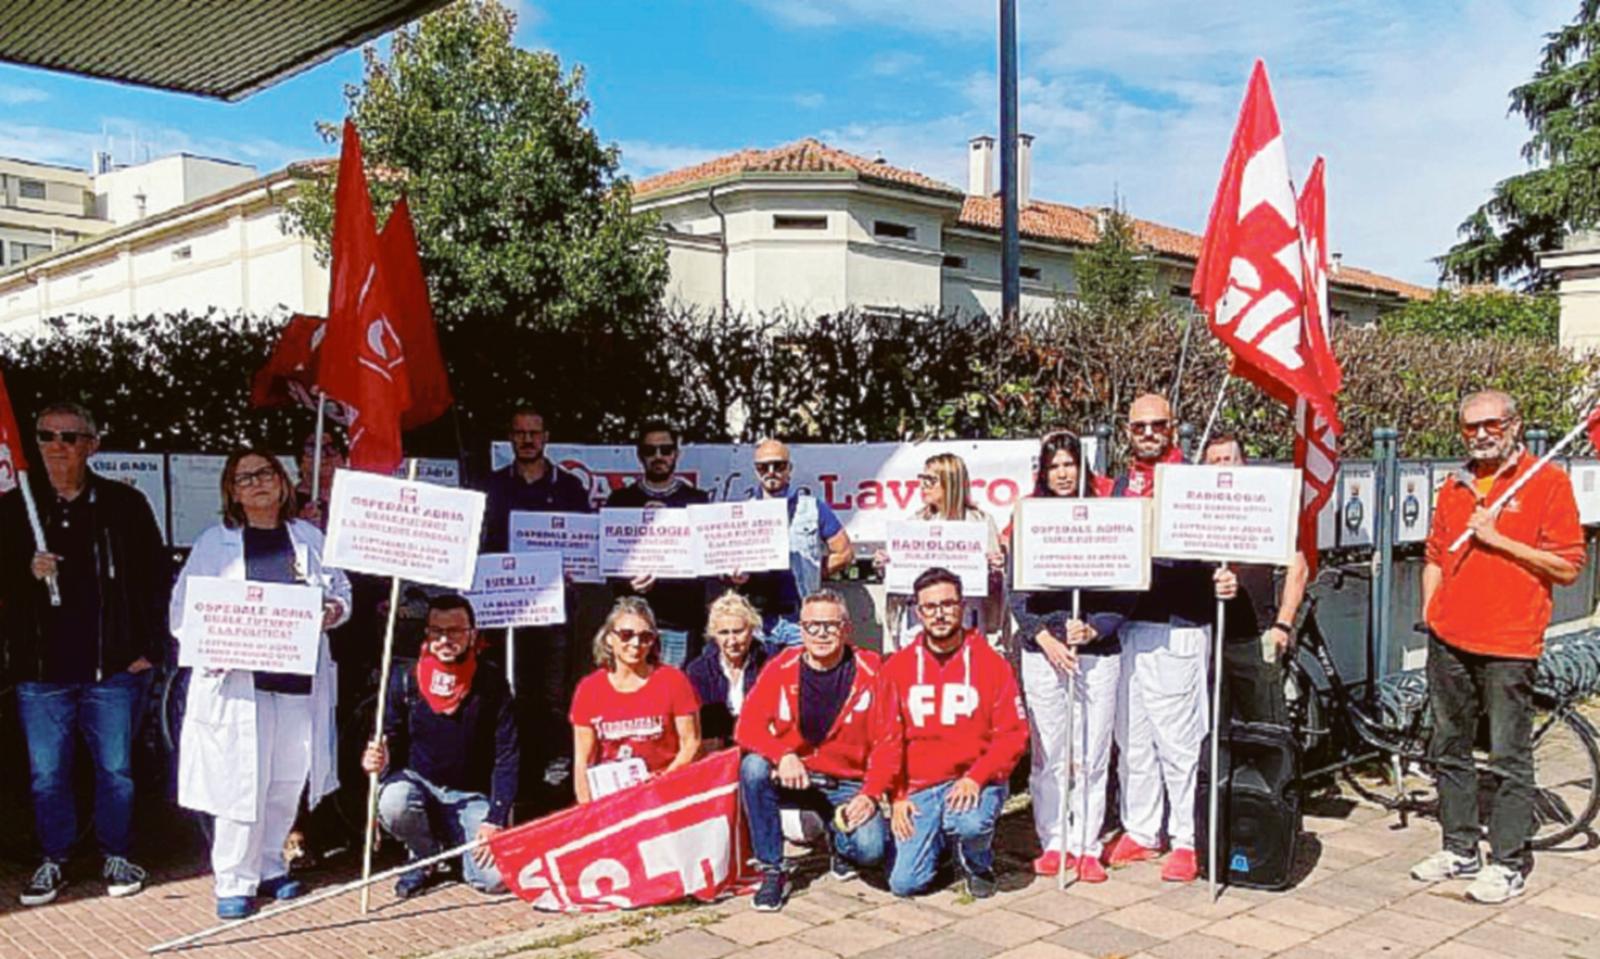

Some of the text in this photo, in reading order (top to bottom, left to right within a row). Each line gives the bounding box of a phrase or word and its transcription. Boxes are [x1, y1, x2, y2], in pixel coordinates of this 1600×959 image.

[818, 474, 1020, 510] Lavro
[1186, 490, 1266, 503] RADIOLOGIA
[351, 496, 465, 522] OSPEDALE ADRIA
[605, 525, 691, 538] RADIOLOGIA
[1030, 523, 1135, 535] OSPEDALE ADRIA
[891, 539, 982, 552] RADIOLOGIA
[194, 602, 314, 620] OSPEDALE ADRIA
[203, 614, 242, 625] QUALE
[908, 683, 979, 727] FP
